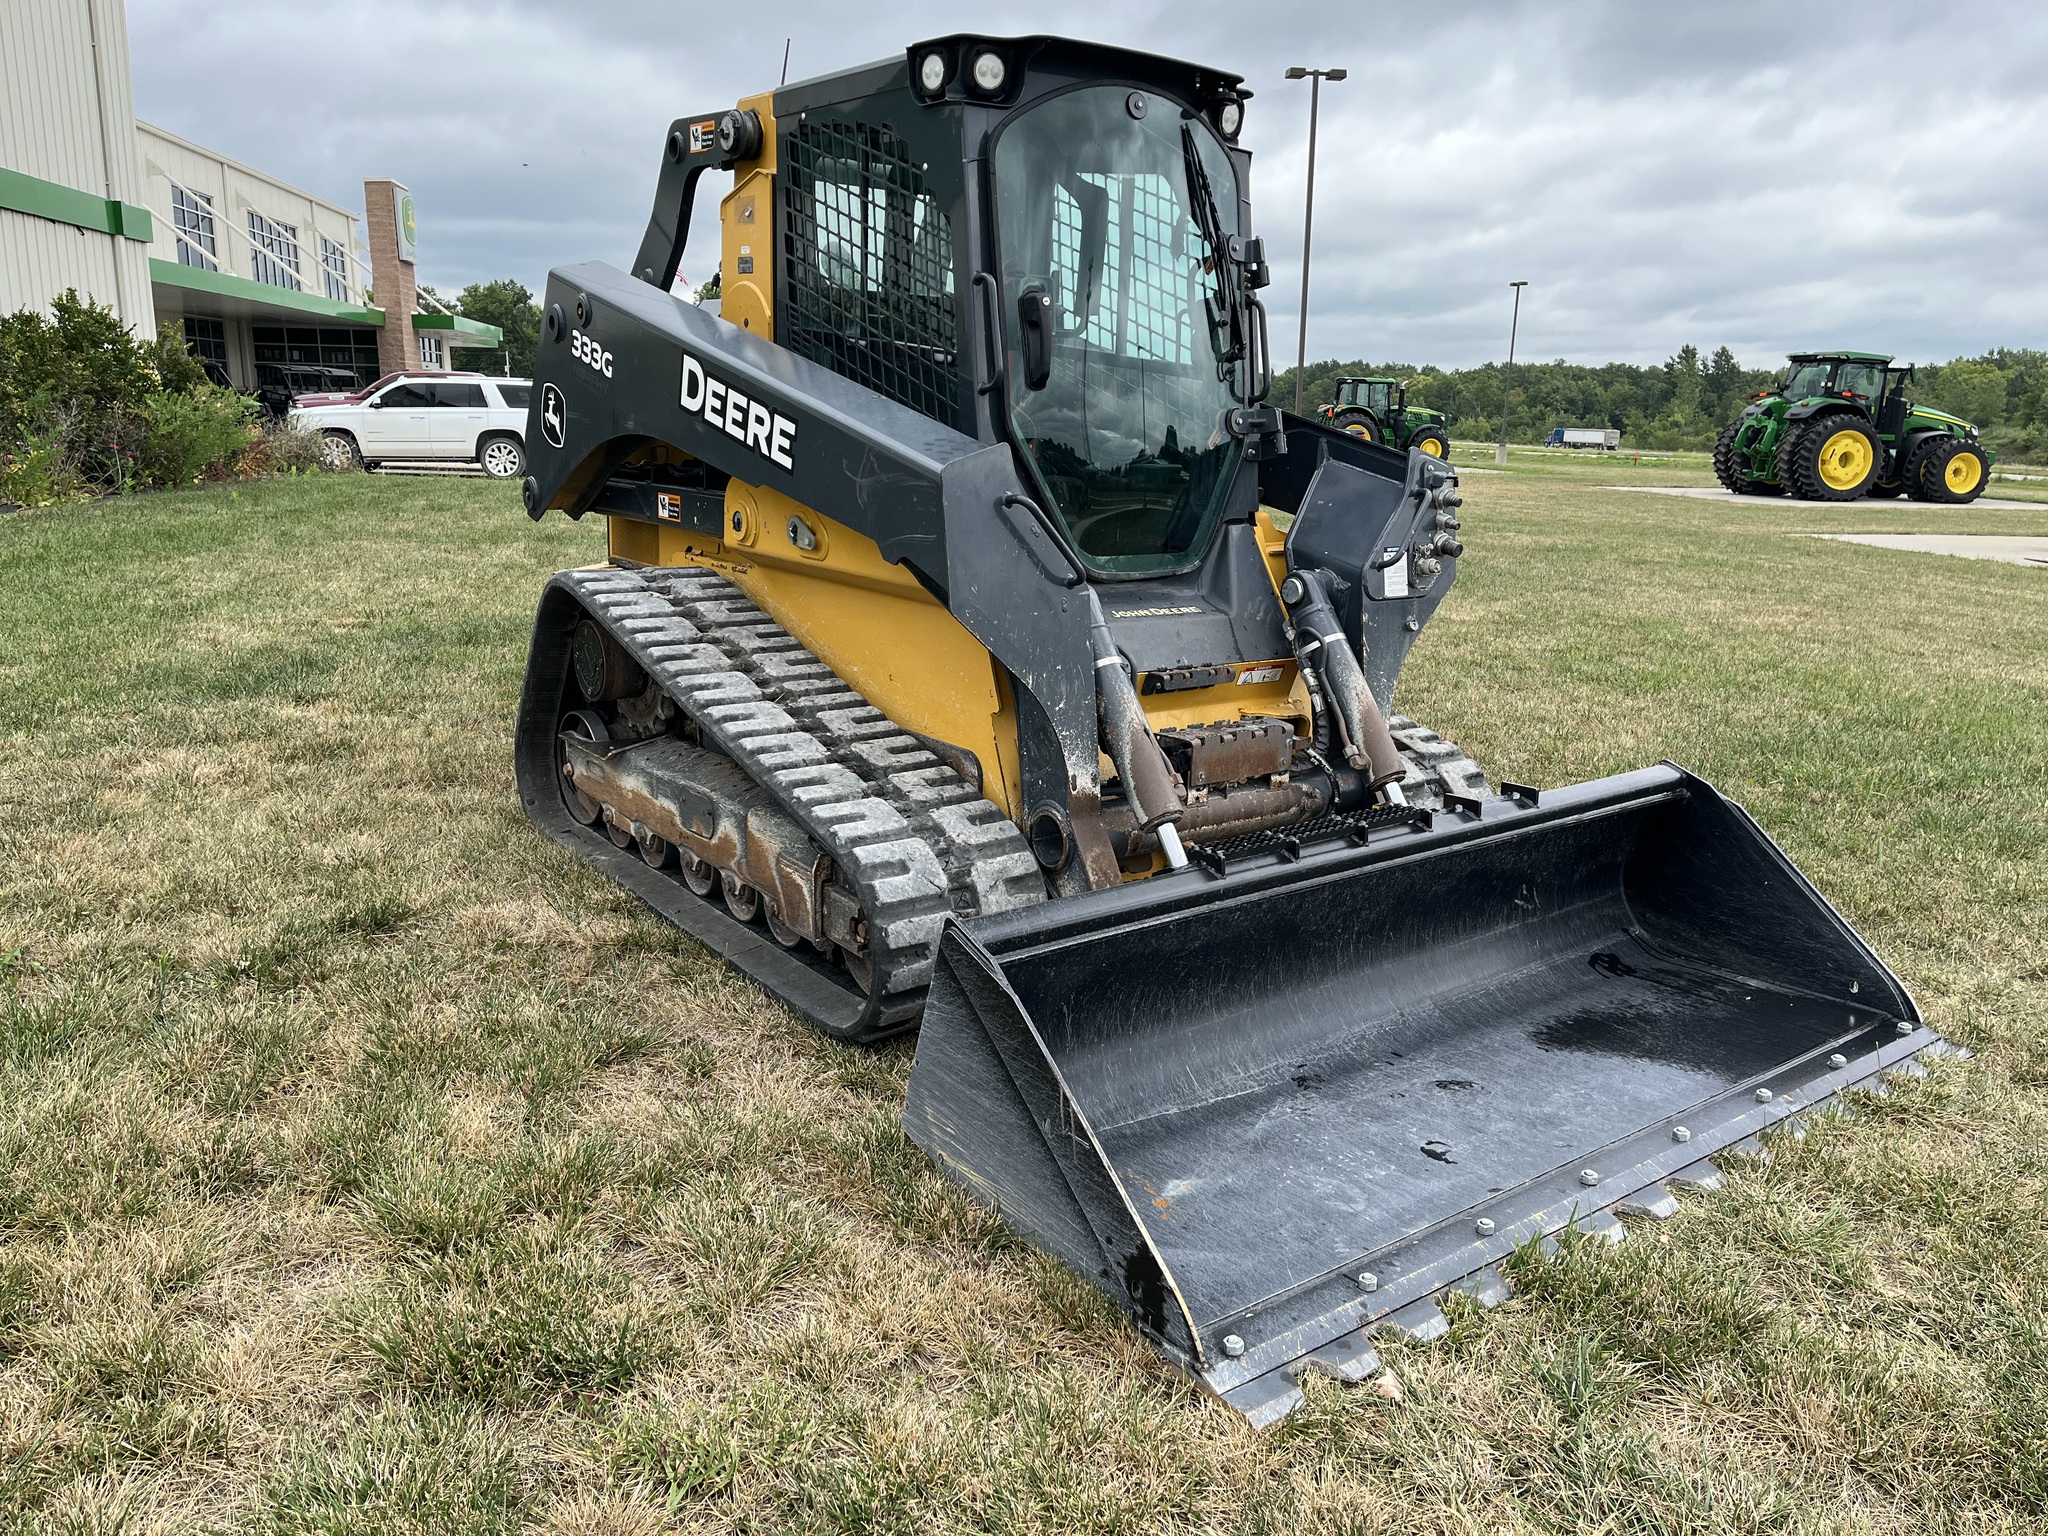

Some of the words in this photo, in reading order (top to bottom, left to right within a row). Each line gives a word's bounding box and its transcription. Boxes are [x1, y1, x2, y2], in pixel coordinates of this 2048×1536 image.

[571, 329, 613, 379] 333G
[680, 354, 797, 470] DEERE
[1111, 609, 1152, 618] JOHN
[1150, 606, 1200, 616] DEERE
